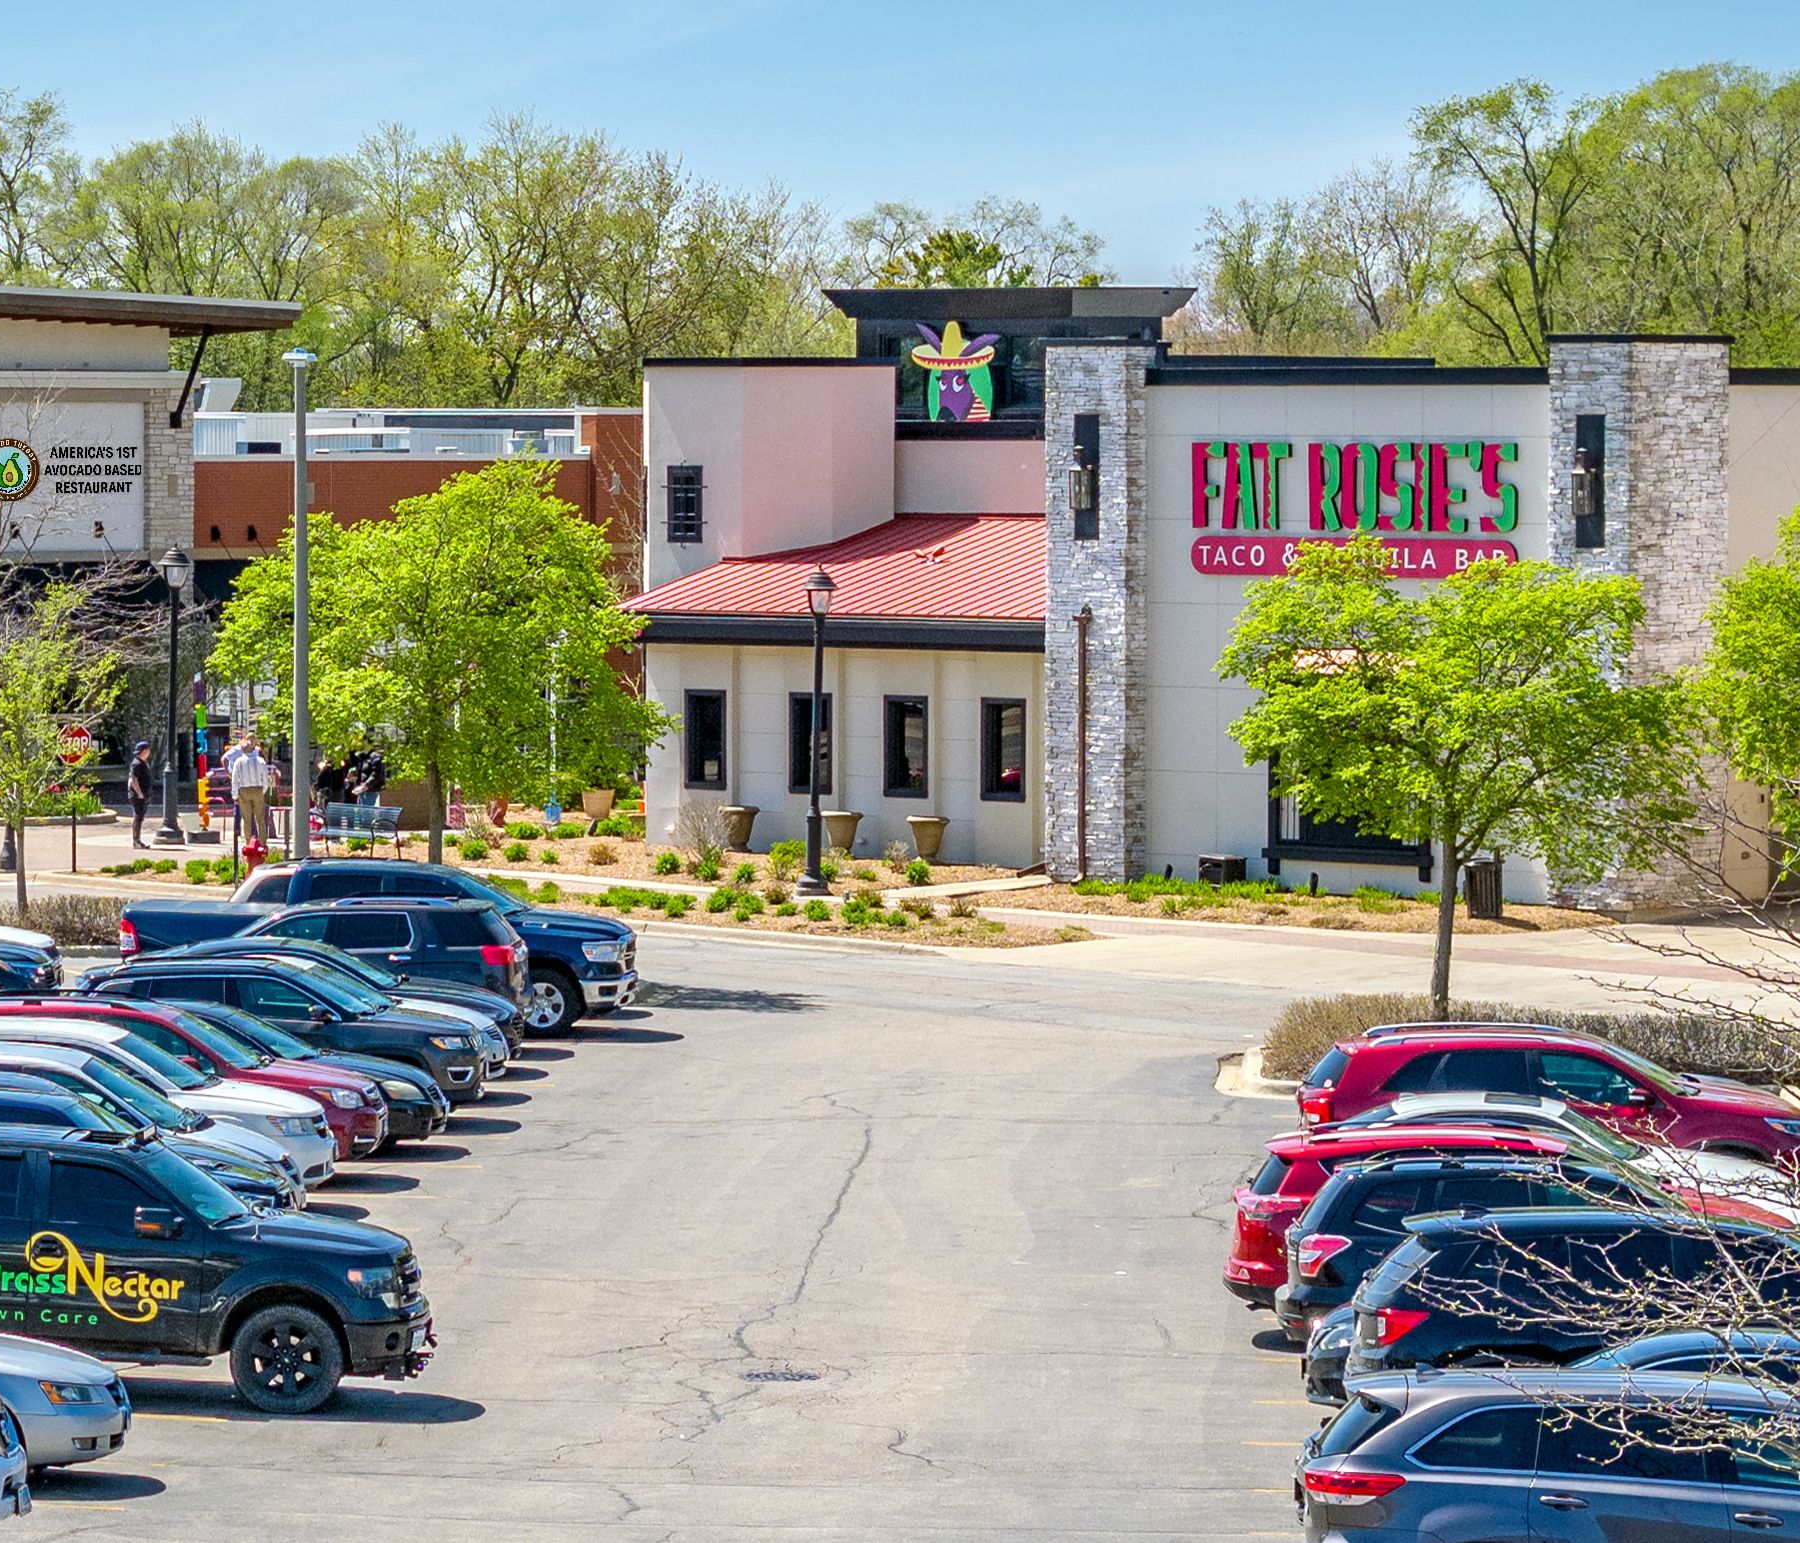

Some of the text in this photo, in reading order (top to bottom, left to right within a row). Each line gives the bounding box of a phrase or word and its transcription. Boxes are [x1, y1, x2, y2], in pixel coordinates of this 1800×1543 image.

[49, 446, 138, 459] AMERICA'S 1ST
[43, 463, 142, 476] AVOCADO BASED
[55, 481, 133, 493] RESTAURANT
[1191, 440, 1519, 533] FAT ROSIE'S
[1198, 545, 1265, 566] TACO
[1282, 543, 1299, 567] &
[40, 1308, 99, 1325] Care
